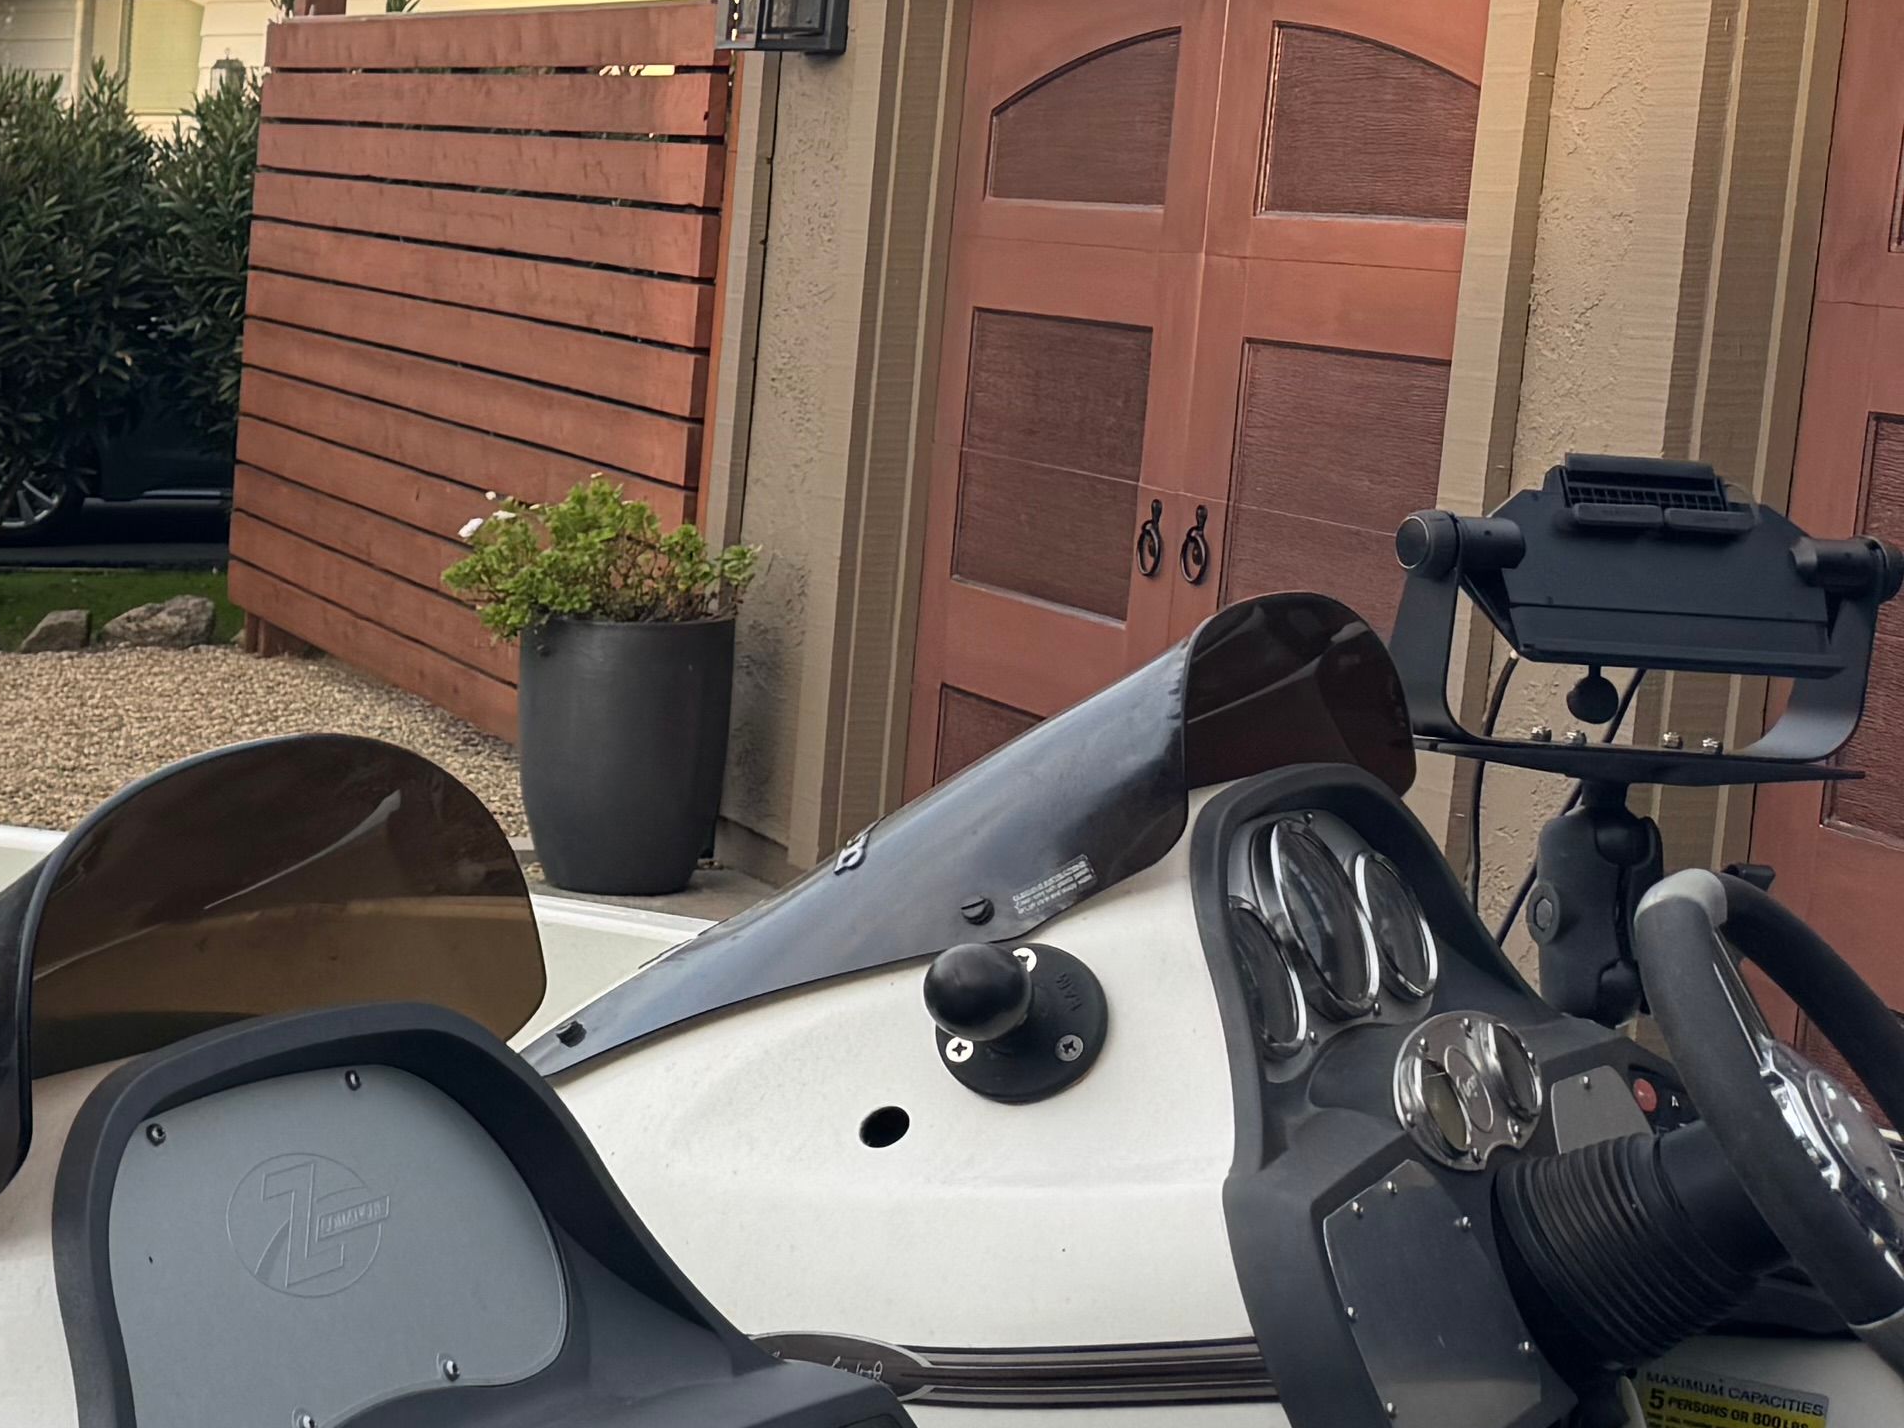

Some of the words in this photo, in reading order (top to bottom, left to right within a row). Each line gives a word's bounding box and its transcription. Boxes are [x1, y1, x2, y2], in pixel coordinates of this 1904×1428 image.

[1646, 1373, 1724, 1397] MAXIMUM
[1728, 1387, 1825, 1417] CAPACITIES
[1648, 1387, 1666, 1410] 5
[1668, 1396, 1728, 1419] PERSONS
[1731, 1408, 1750, 1422] OR
